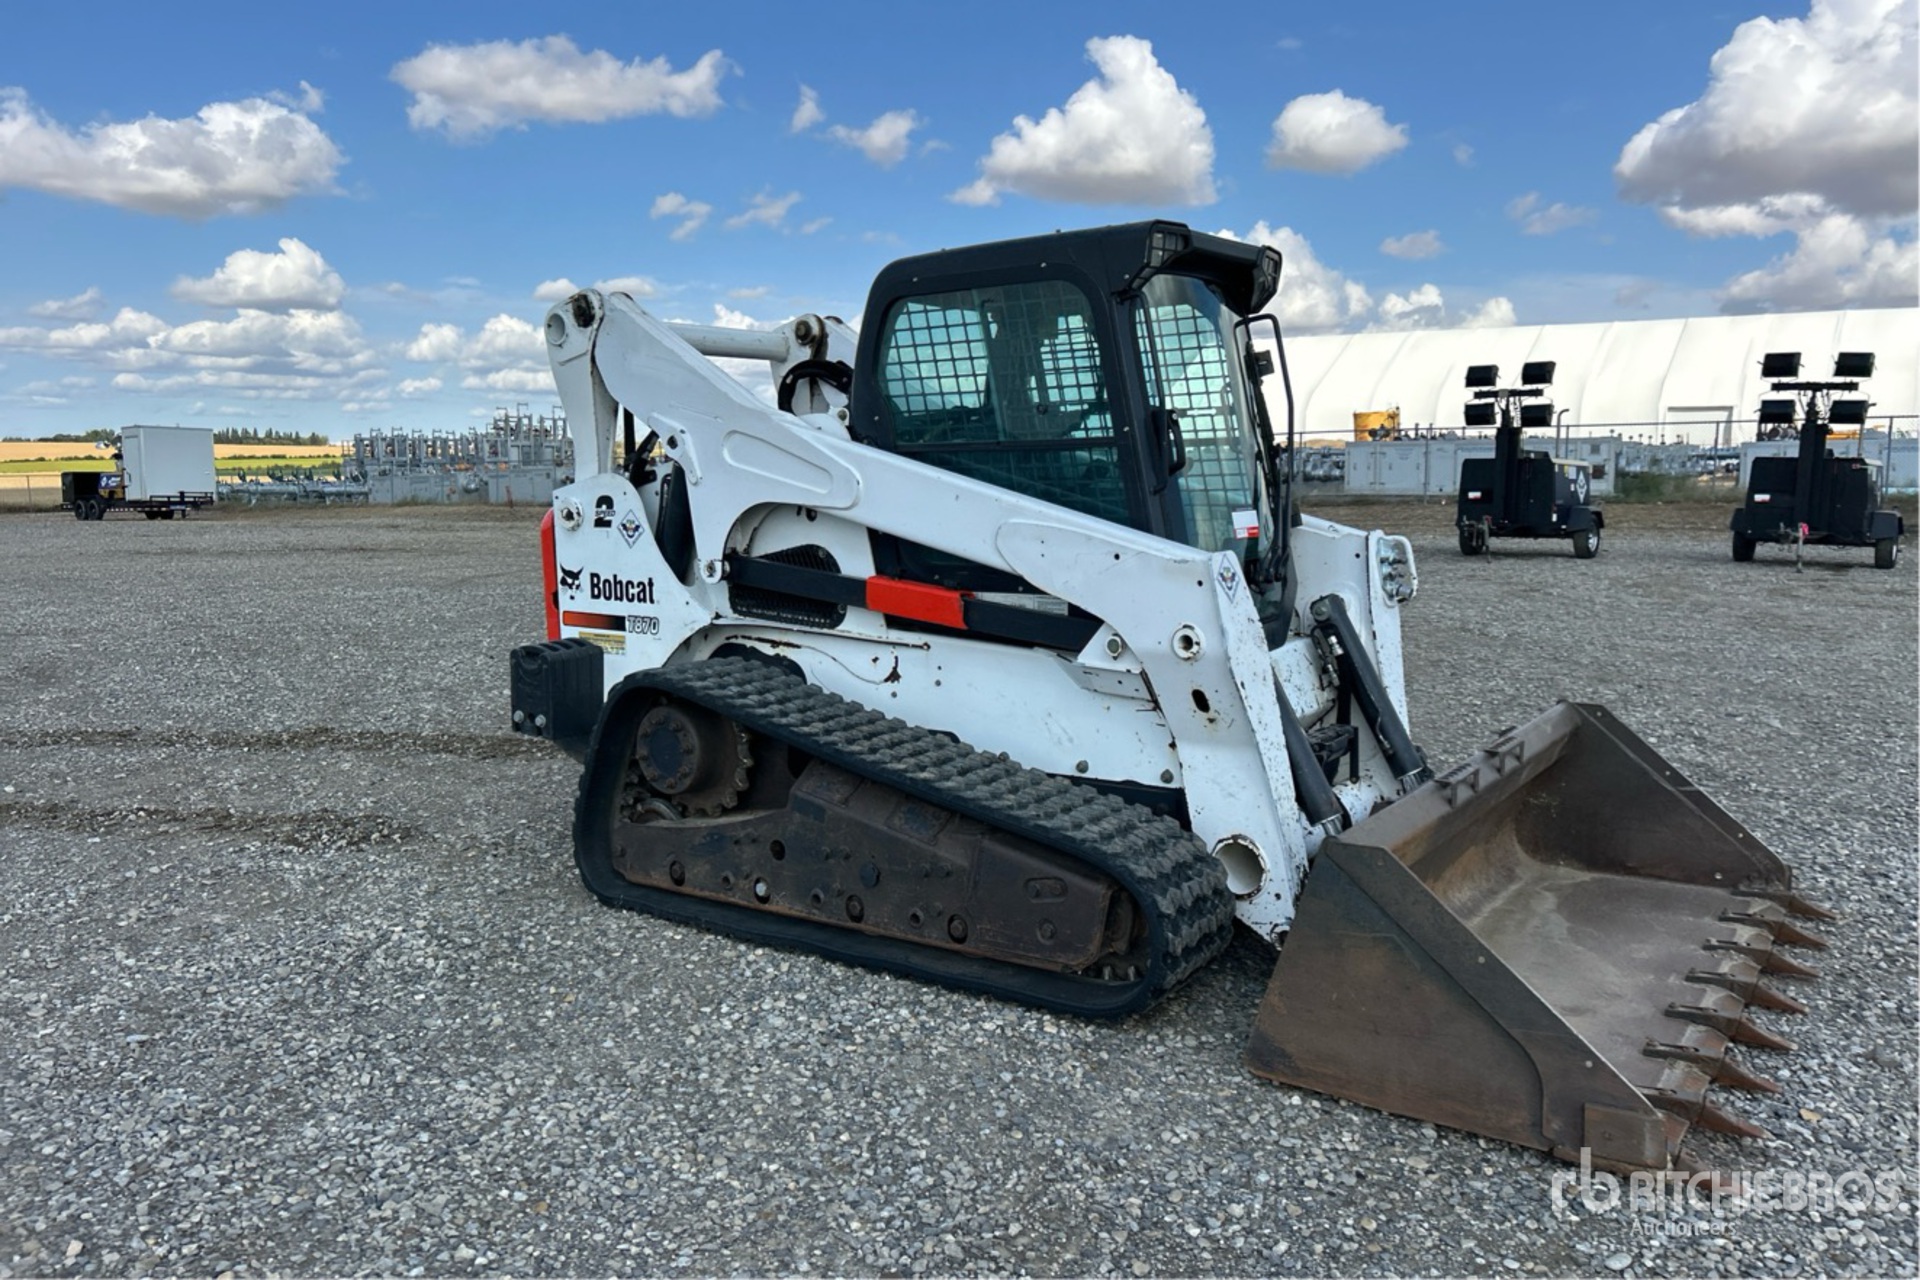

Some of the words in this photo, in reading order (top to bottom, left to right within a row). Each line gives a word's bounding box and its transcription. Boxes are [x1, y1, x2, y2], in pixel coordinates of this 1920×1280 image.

[593, 494, 615, 528] 2
[590, 572, 655, 604] Bobcat
[627, 614, 660, 635] T870
